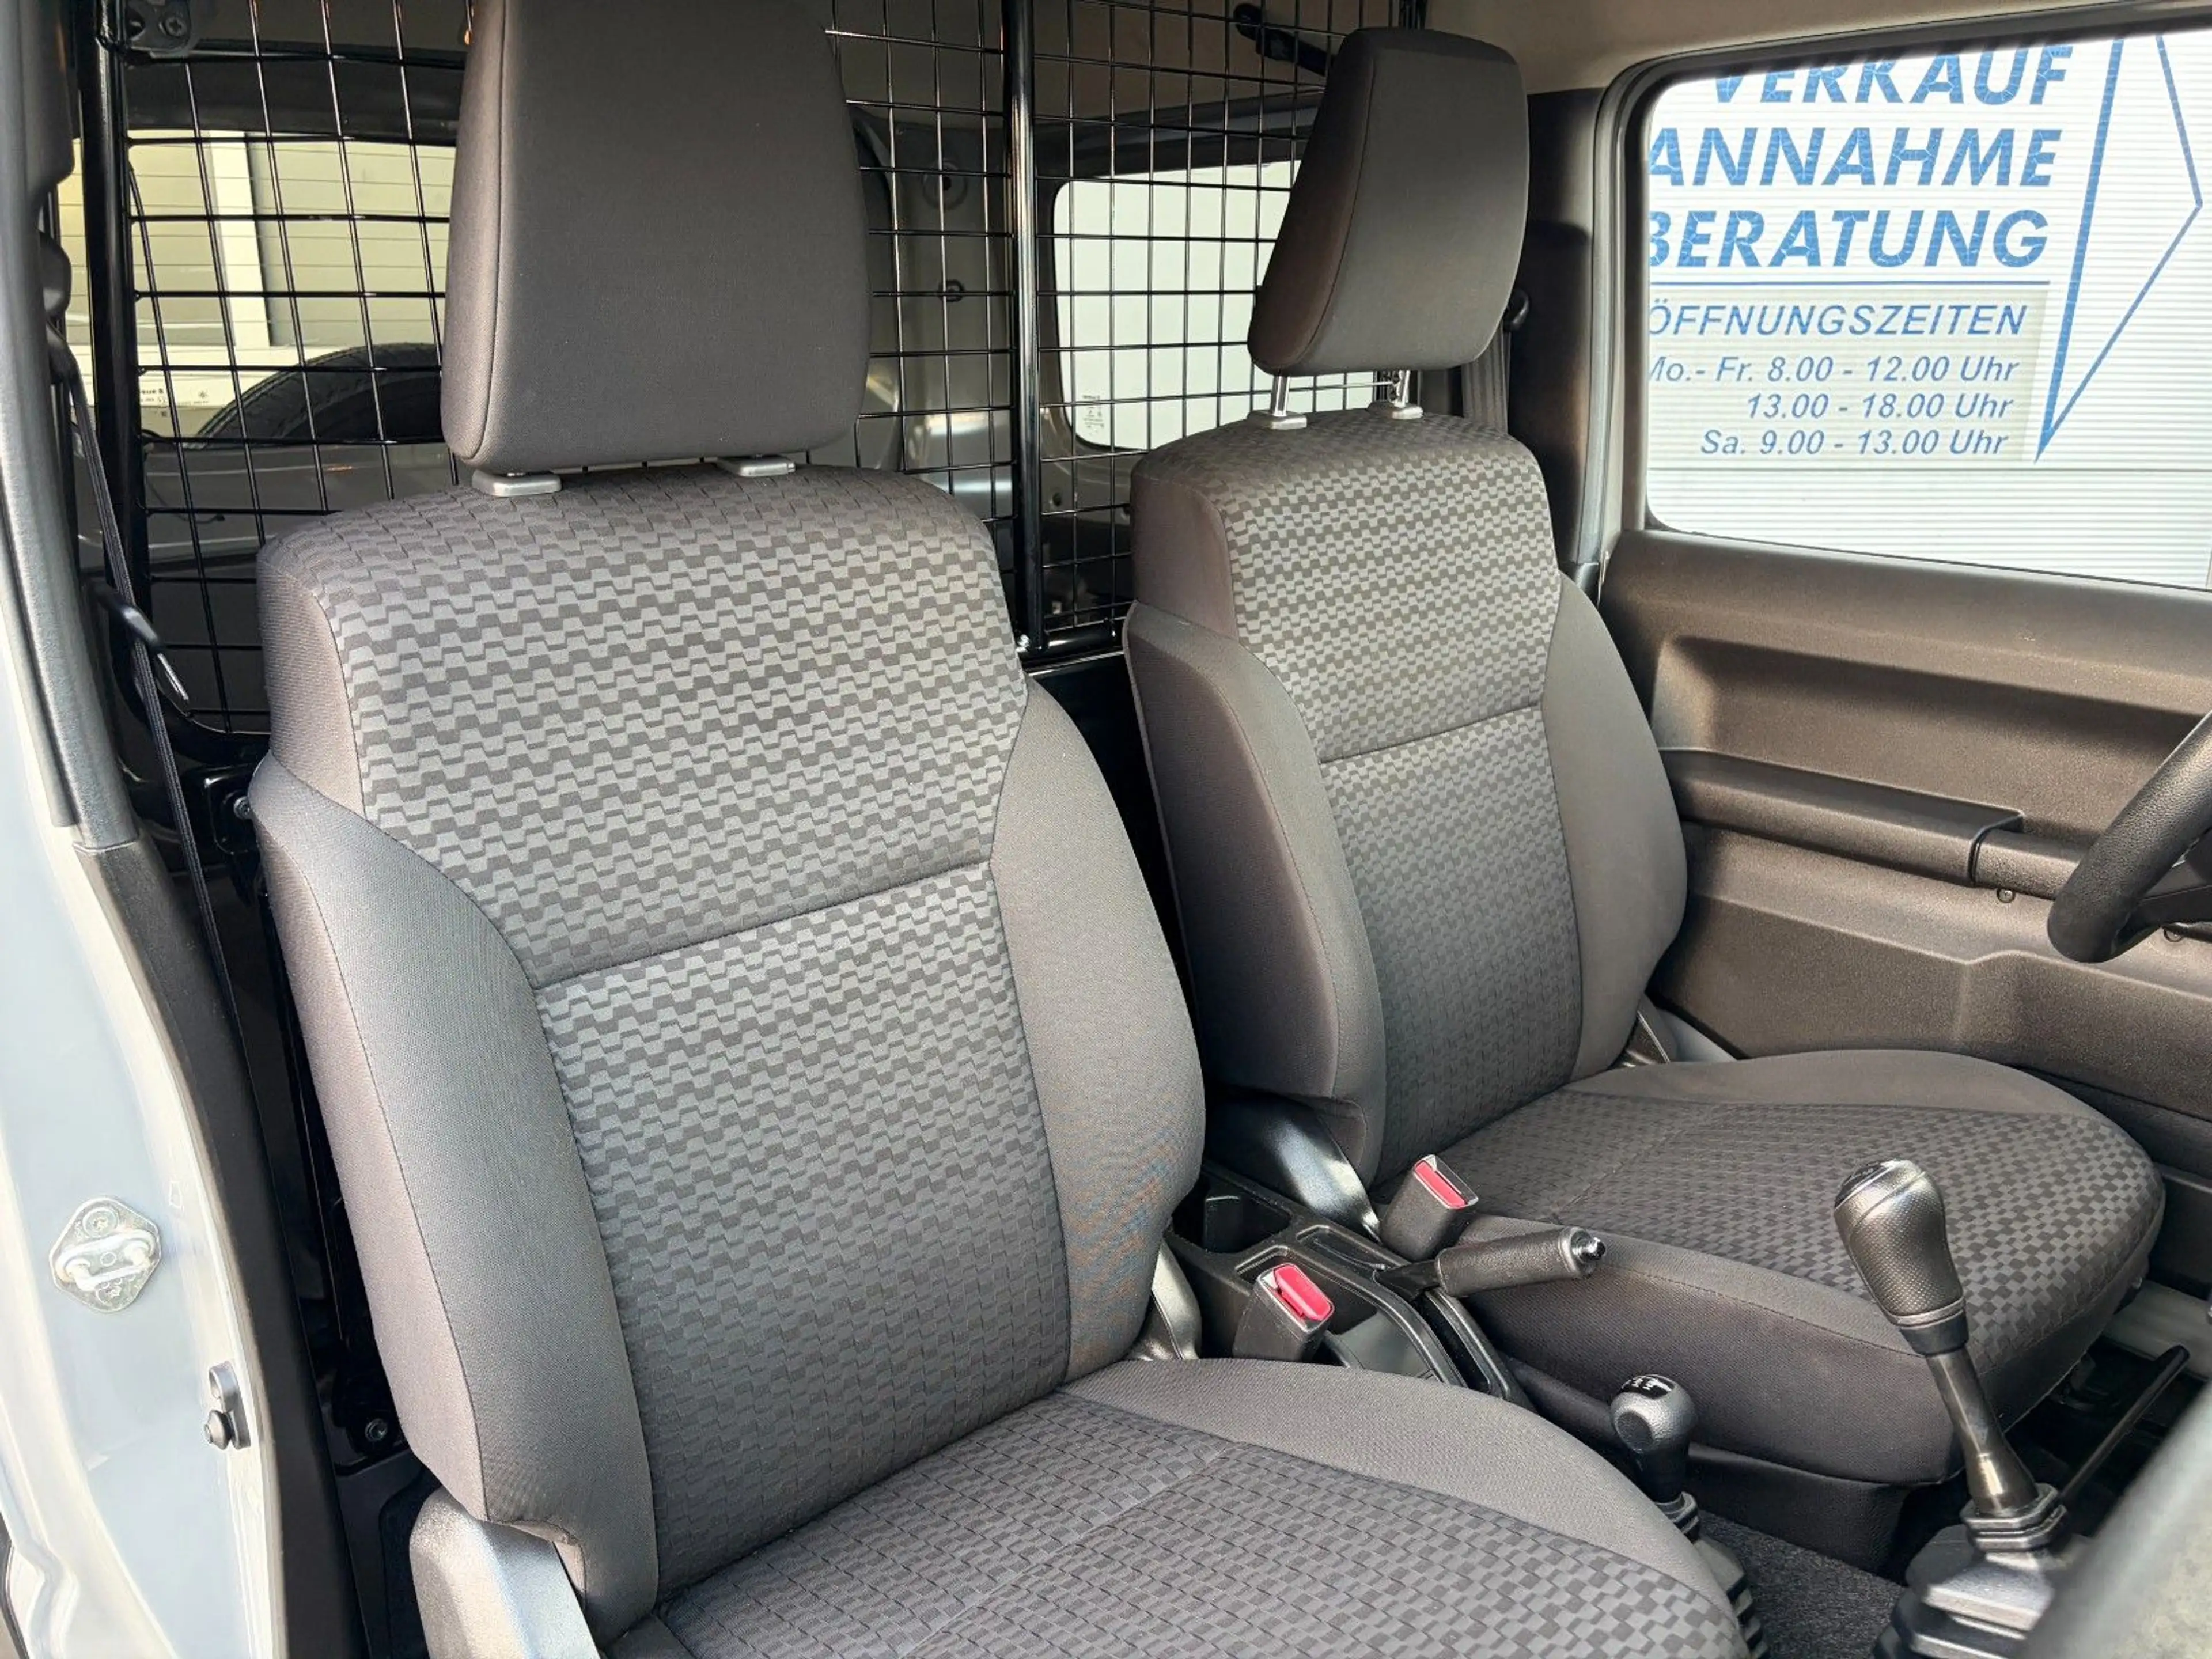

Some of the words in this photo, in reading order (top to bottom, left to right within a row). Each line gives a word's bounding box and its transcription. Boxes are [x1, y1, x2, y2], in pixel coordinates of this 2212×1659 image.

[1649, 127, 2063, 187] ANNAHME
[1649, 209, 2049, 267] BERATUNG
[1650, 298, 2028, 335] ÖFFNUNGSZEITEN
[1715, 356, 1753, 382] Fr.
[1767, 356, 1834, 382] 8.00
[1866, 355, 1950, 382] 12.00
[1960, 355, 2021, 382] Uhr
[1747, 393, 1830, 419] 13.00
[1862, 393, 1945, 419] 18.00
[1955, 393, 2014, 419] Uhr
[1700, 429, 1745, 455] Sa.
[1759, 429, 1825, 455] 9.00
[1858, 429, 1940, 455] 13.00
[1949, 429, 2009, 455] Uhr
